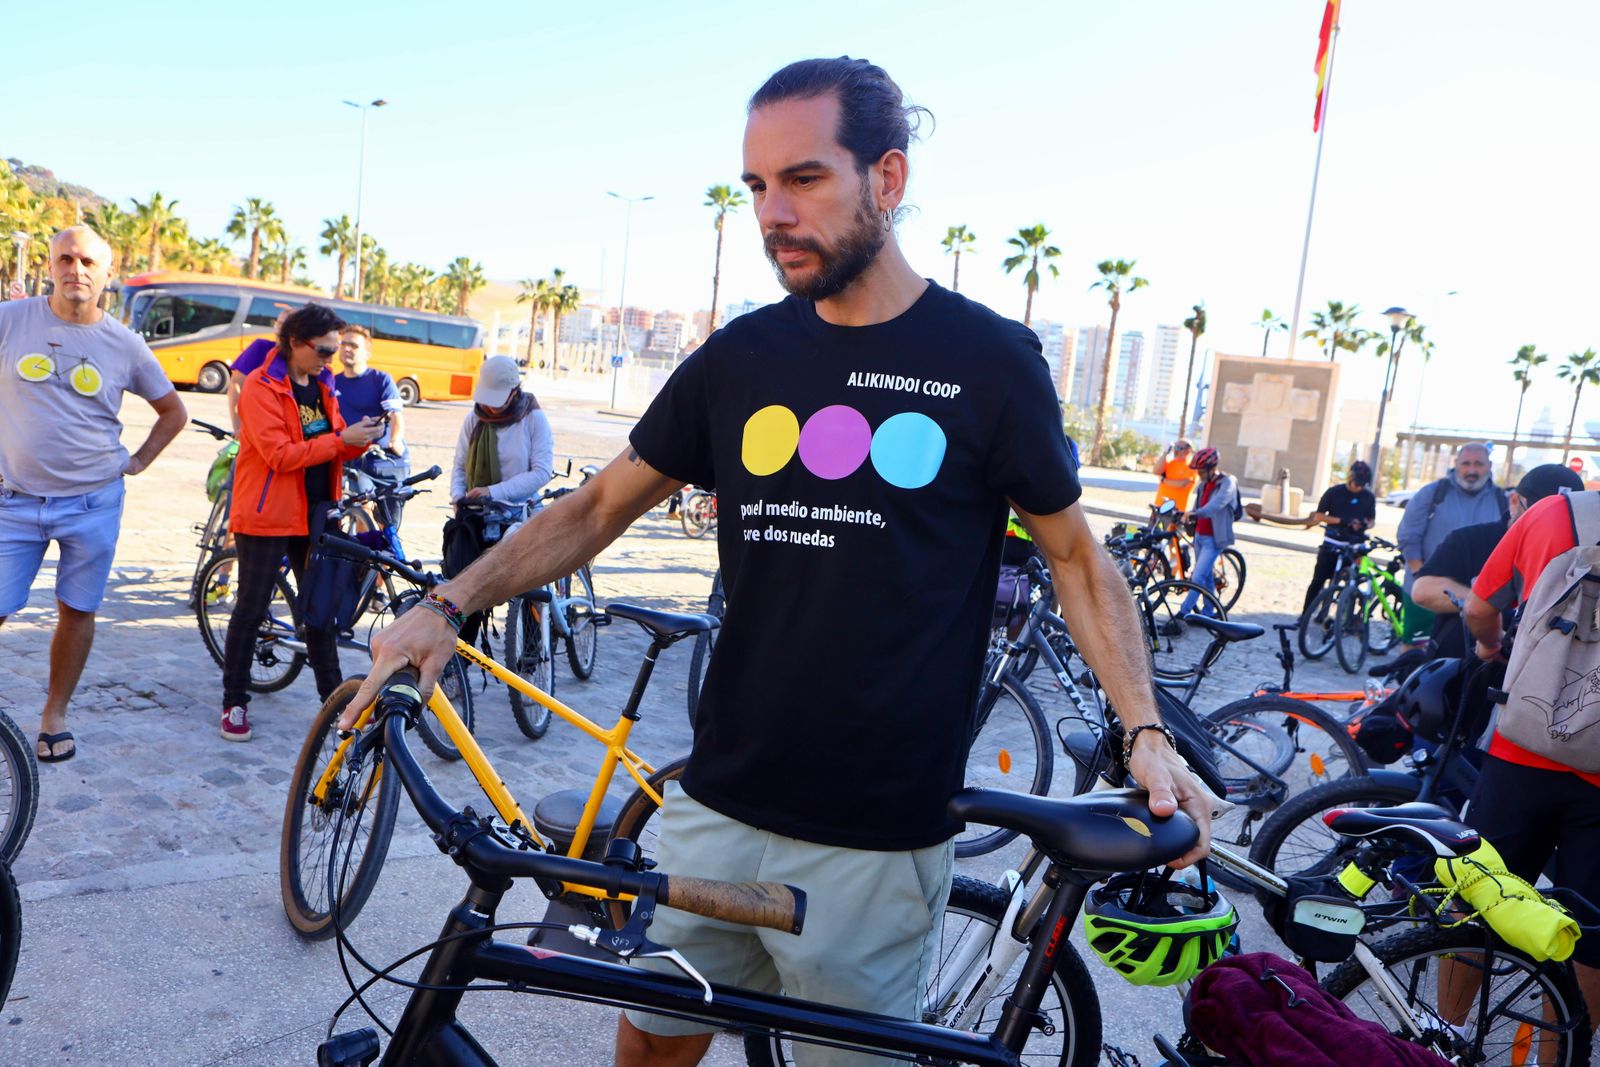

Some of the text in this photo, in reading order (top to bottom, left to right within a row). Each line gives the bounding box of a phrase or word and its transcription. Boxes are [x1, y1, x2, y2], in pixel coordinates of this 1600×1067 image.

[847, 372, 961, 399] ALIKINDOI COOP
[765, 501, 808, 518] medio
[811, 504, 887, 529] ambiente,
[764, 525, 788, 541] dos
[790, 529, 835, 548] ruedas
[1045, 914, 1067, 958] CUBE
